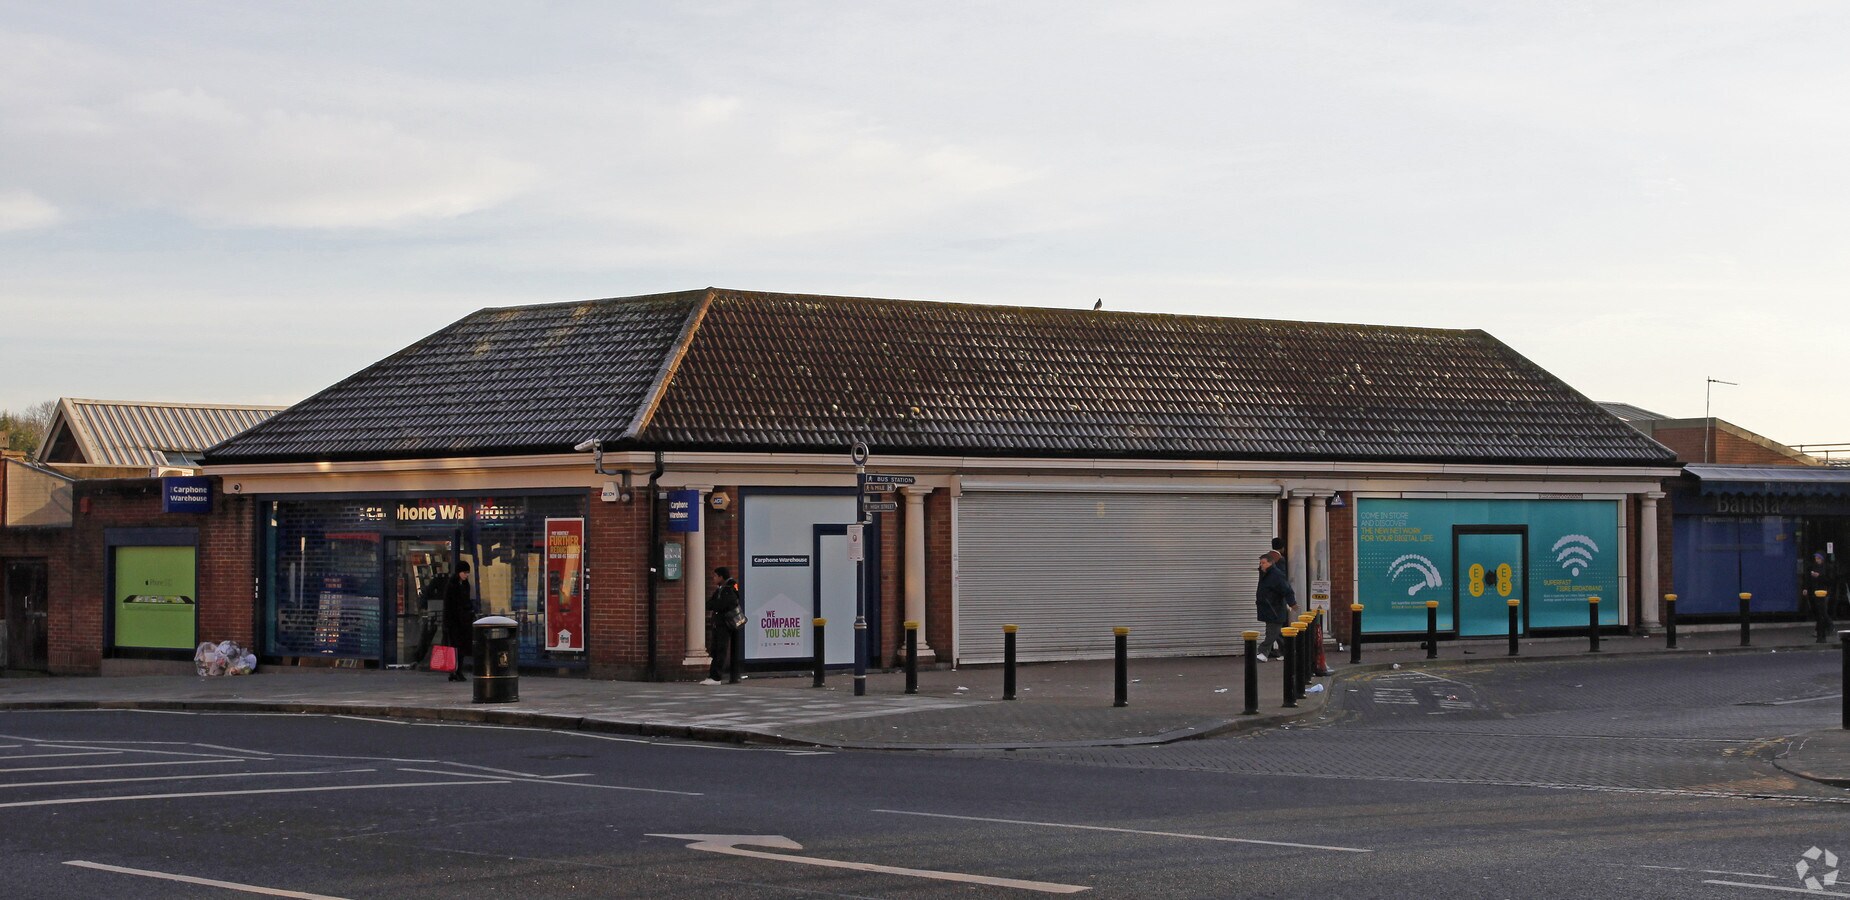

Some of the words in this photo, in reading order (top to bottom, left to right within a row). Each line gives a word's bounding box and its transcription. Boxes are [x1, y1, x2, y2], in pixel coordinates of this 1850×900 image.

[173, 486, 208, 494] Carphone
[670, 502, 688, 510] Carphone
[1716, 496, 1780, 514] Barista
[550, 536, 579, 546] FURTHER
[761, 618, 800, 628] COMPARE
[765, 628, 780, 638] YOU
[782, 628, 800, 638] SAVE
